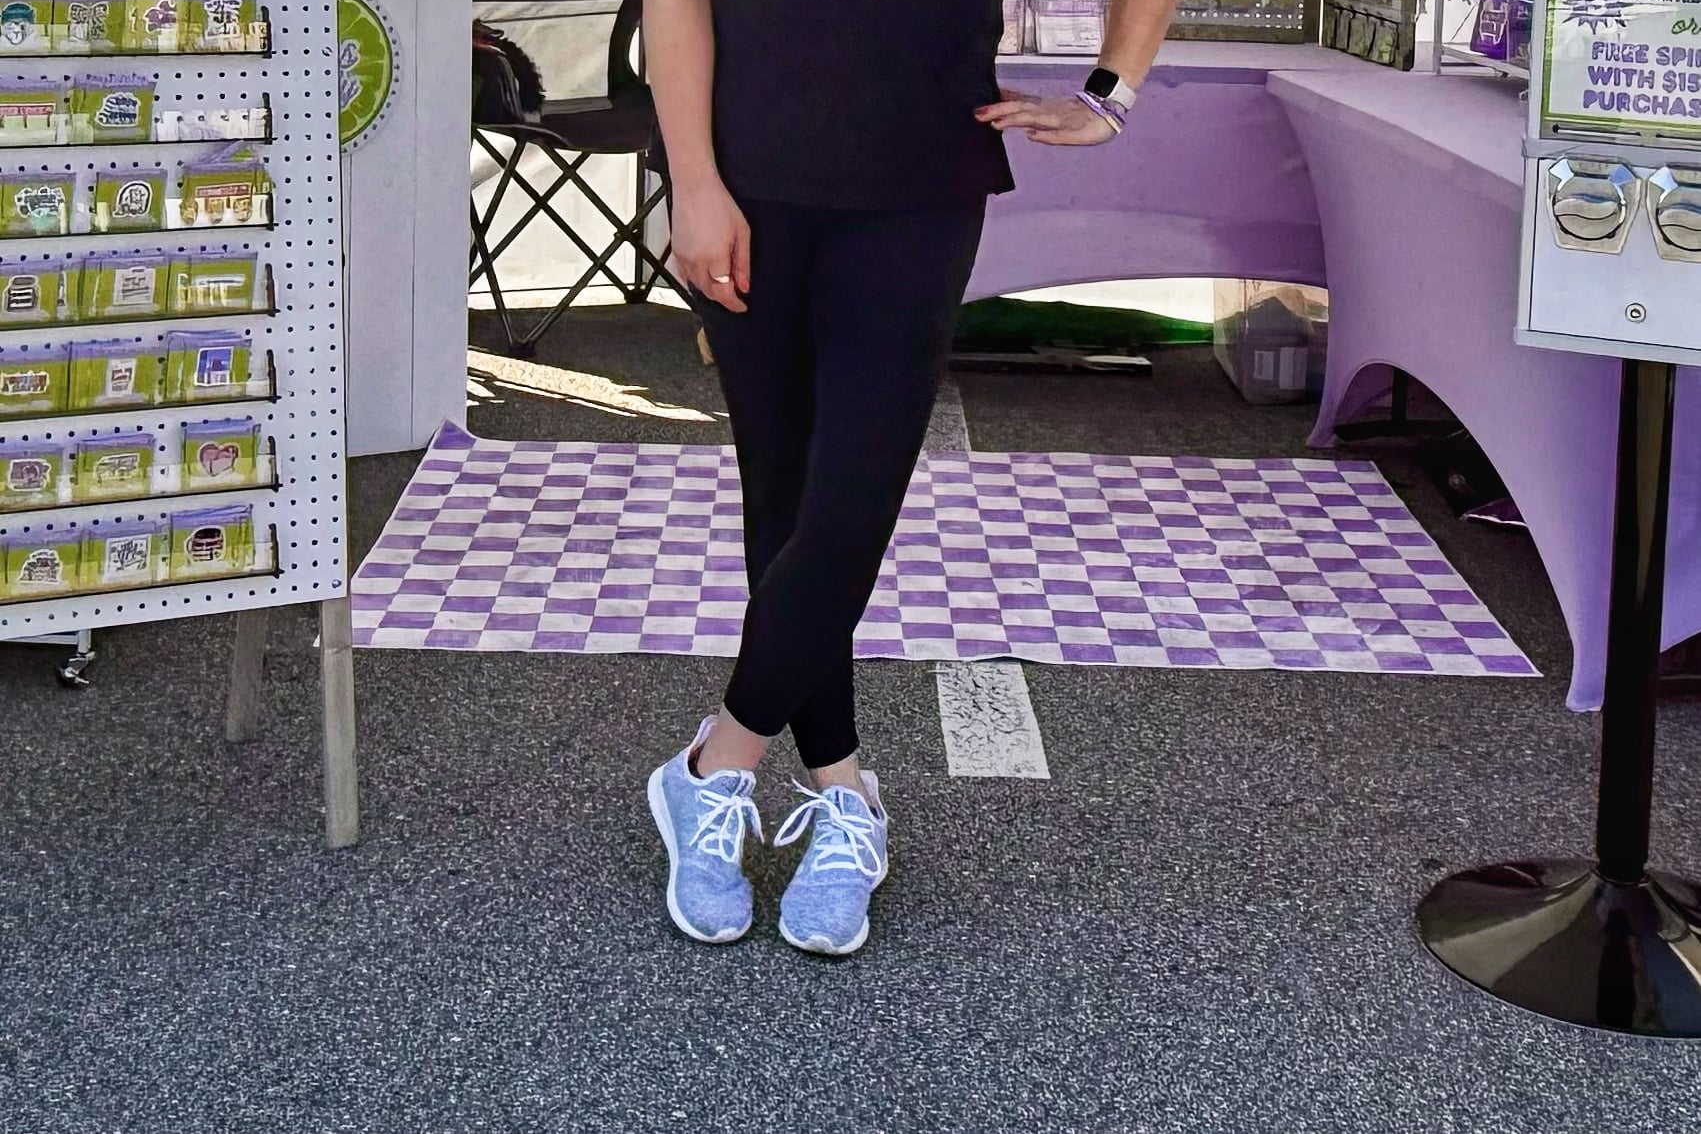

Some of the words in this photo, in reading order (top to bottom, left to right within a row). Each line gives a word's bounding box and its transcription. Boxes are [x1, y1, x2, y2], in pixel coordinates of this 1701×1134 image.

[1592, 41, 1650, 64] FREE
[1587, 65, 1656, 90] WITH
[1662, 70, 1701, 94] $15
[1583, 89, 1701, 118] PURCHAS
